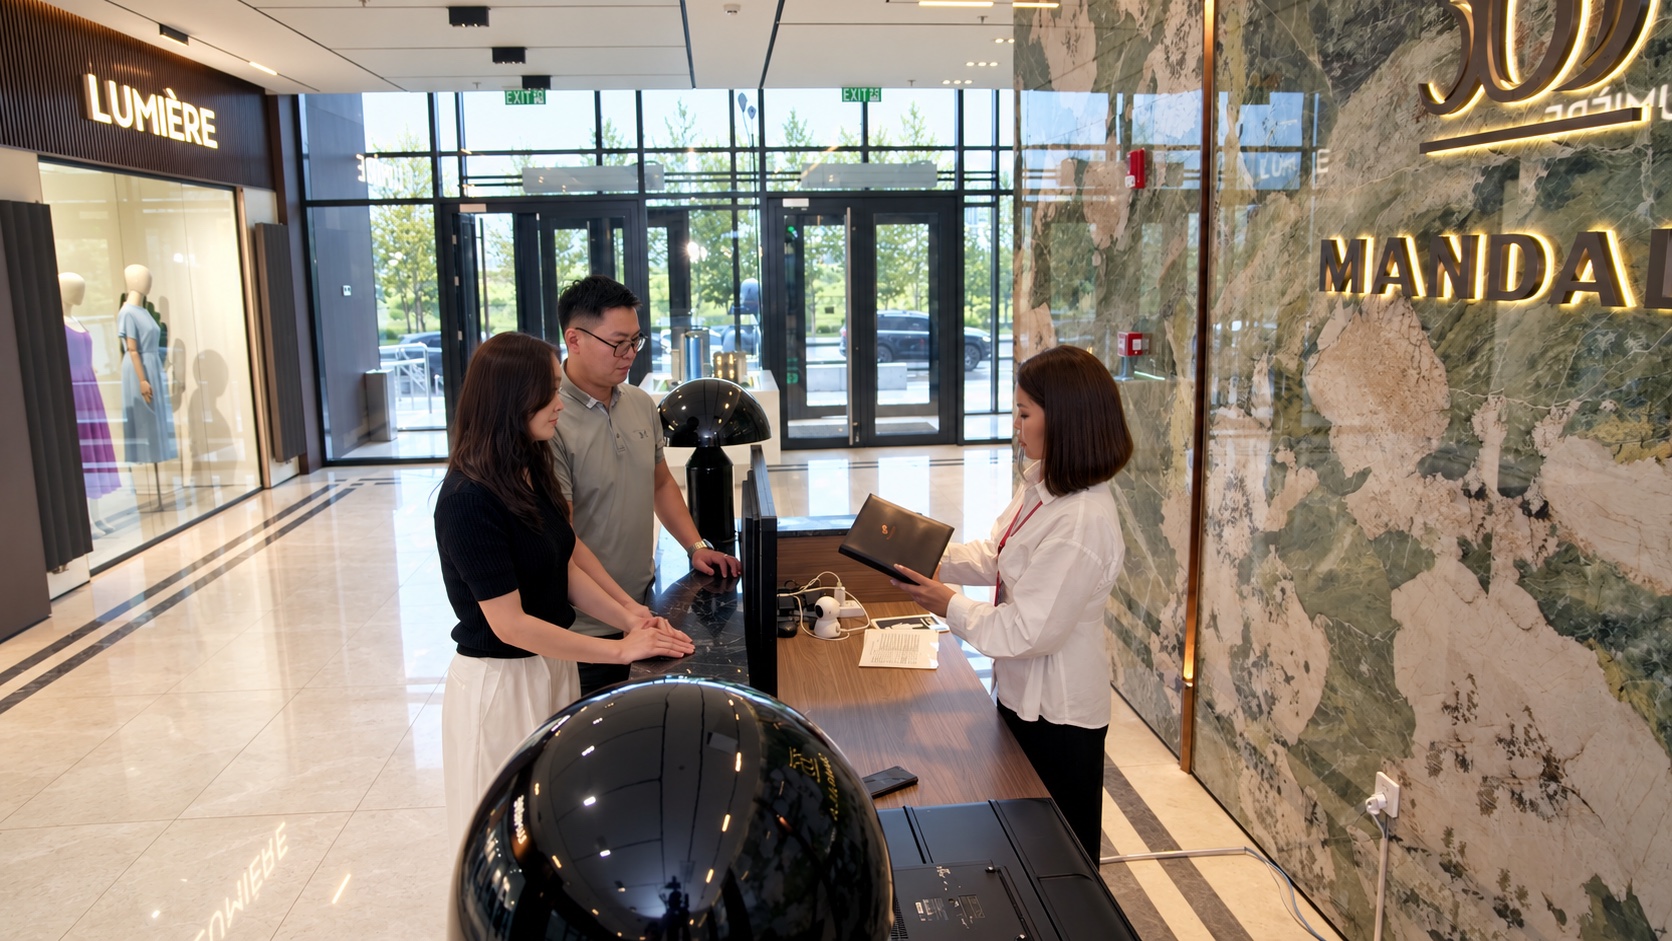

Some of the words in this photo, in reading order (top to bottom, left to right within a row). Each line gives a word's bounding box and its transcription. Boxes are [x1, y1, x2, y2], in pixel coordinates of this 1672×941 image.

[506, 90, 531, 104] EXIT
[843, 88, 868, 102] EXIT
[85, 73, 219, 149] LUMIÈRE
